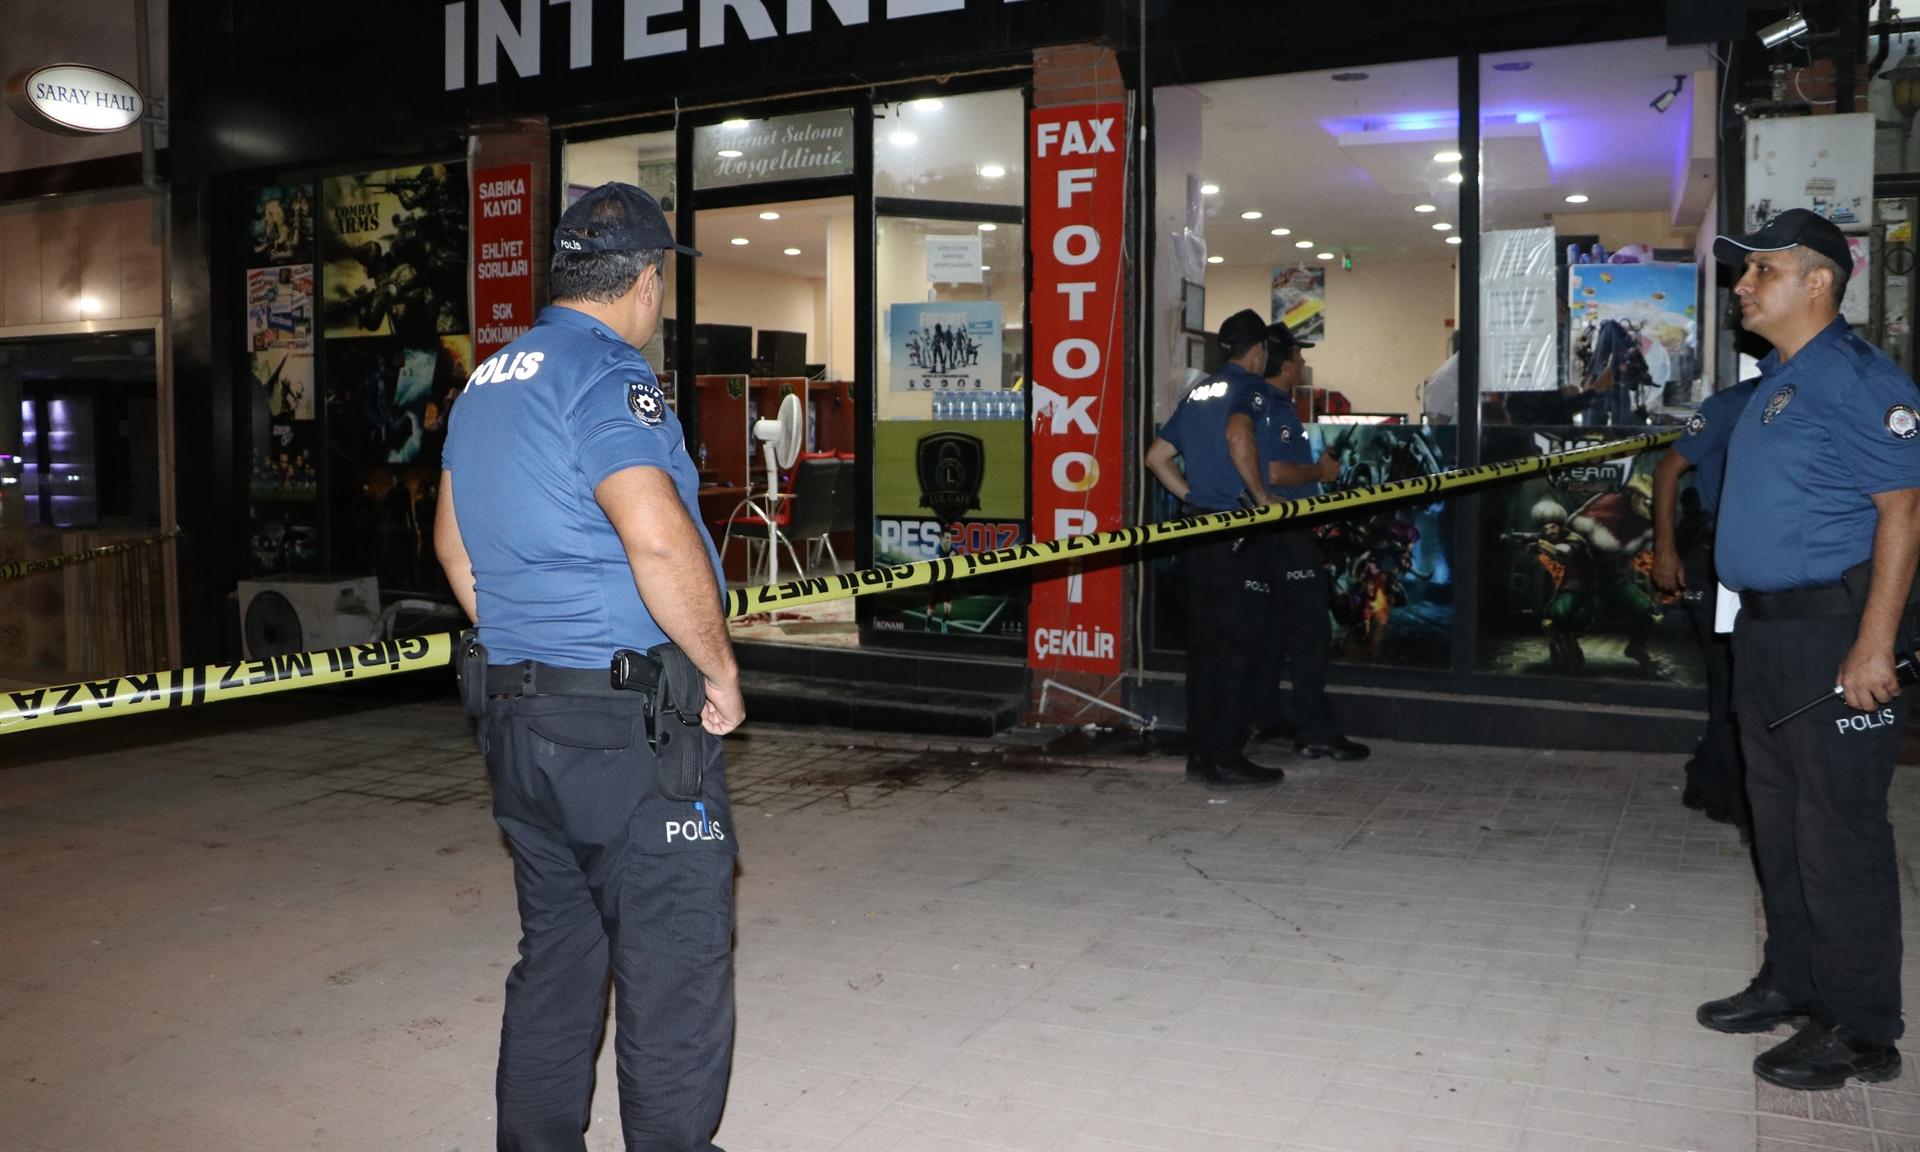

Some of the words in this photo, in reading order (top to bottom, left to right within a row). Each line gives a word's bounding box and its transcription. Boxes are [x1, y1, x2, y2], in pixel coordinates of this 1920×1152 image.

[444, 0, 1030, 91] INTER
[36, 82, 90, 106] SARAY
[95, 91, 136, 112] HALI
[781, 124, 844, 144] Salonu
[1036, 117, 1116, 158] FAX
[479, 178, 525, 199] SABIKA
[483, 199, 522, 218] KAYDI
[482, 238, 523, 259] EHLİYET
[478, 260, 528, 279] SORULARI
[492, 302, 513, 320] SGK
[880, 520, 941, 554] PES
[1034, 624, 1115, 659] ÇEKİLİR
[7, 673, 161, 720] KAZA
